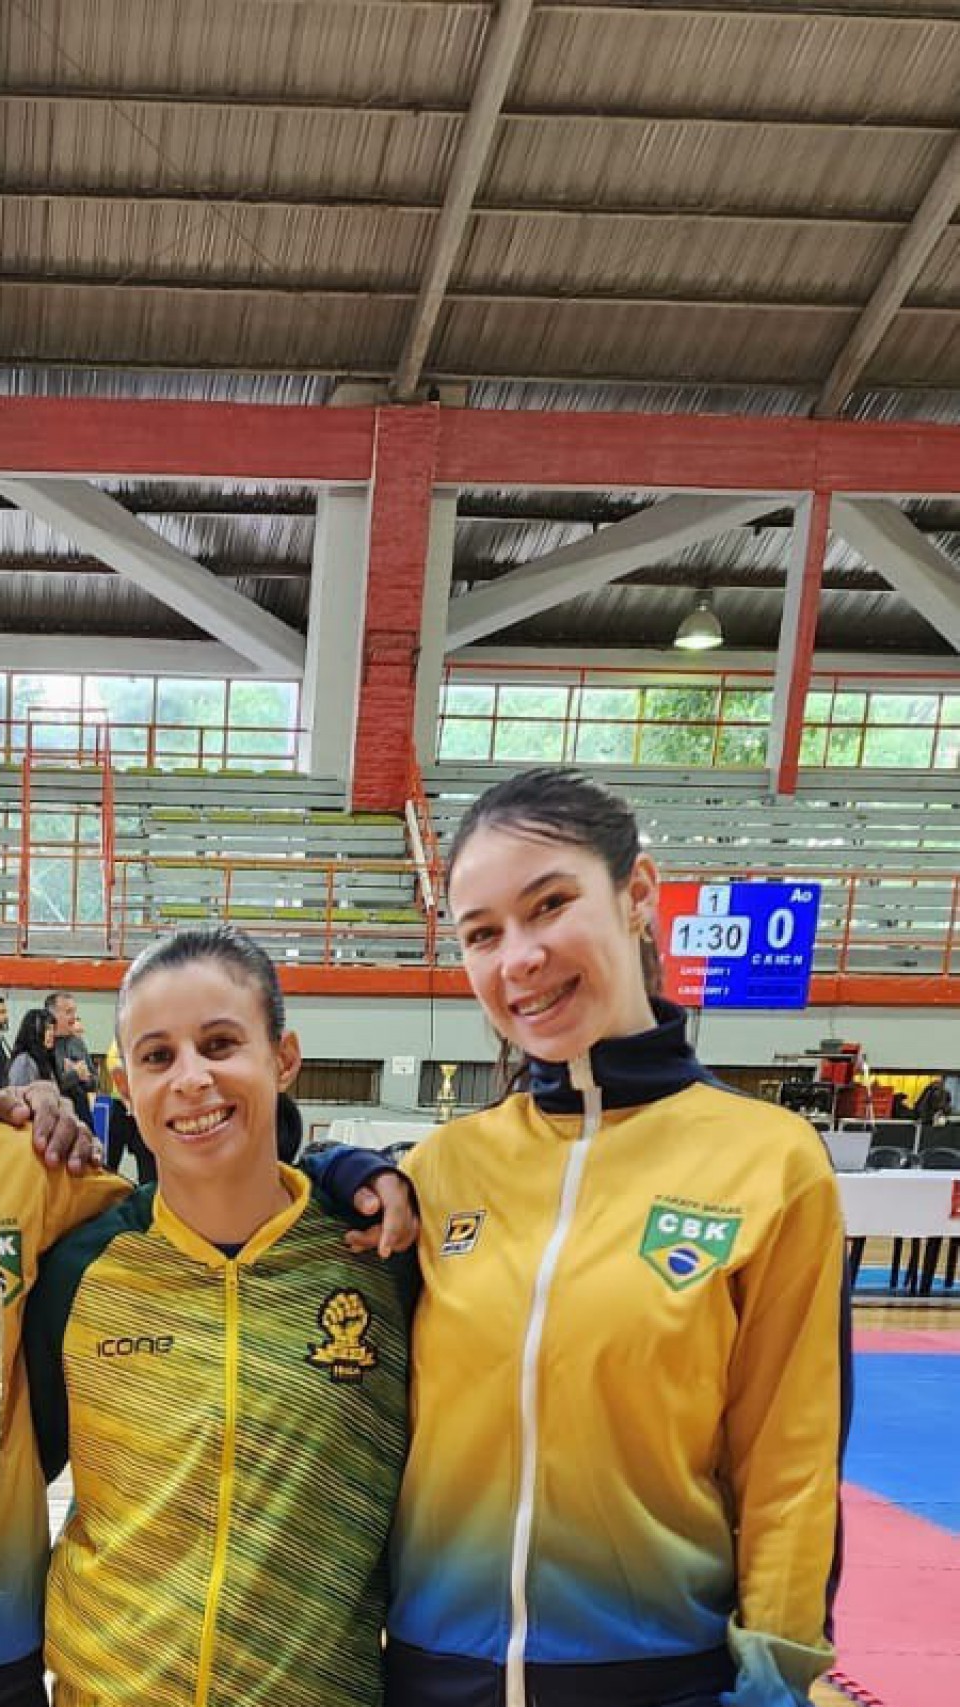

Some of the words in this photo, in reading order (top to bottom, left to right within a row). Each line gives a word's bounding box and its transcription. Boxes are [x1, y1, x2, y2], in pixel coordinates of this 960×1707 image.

[710, 893, 719, 912] 1
[791, 888, 813, 903] Ao
[678, 923, 743, 950] 1:30
[767, 908, 795, 949] 0
[658, 1213, 730, 1241] CBK
